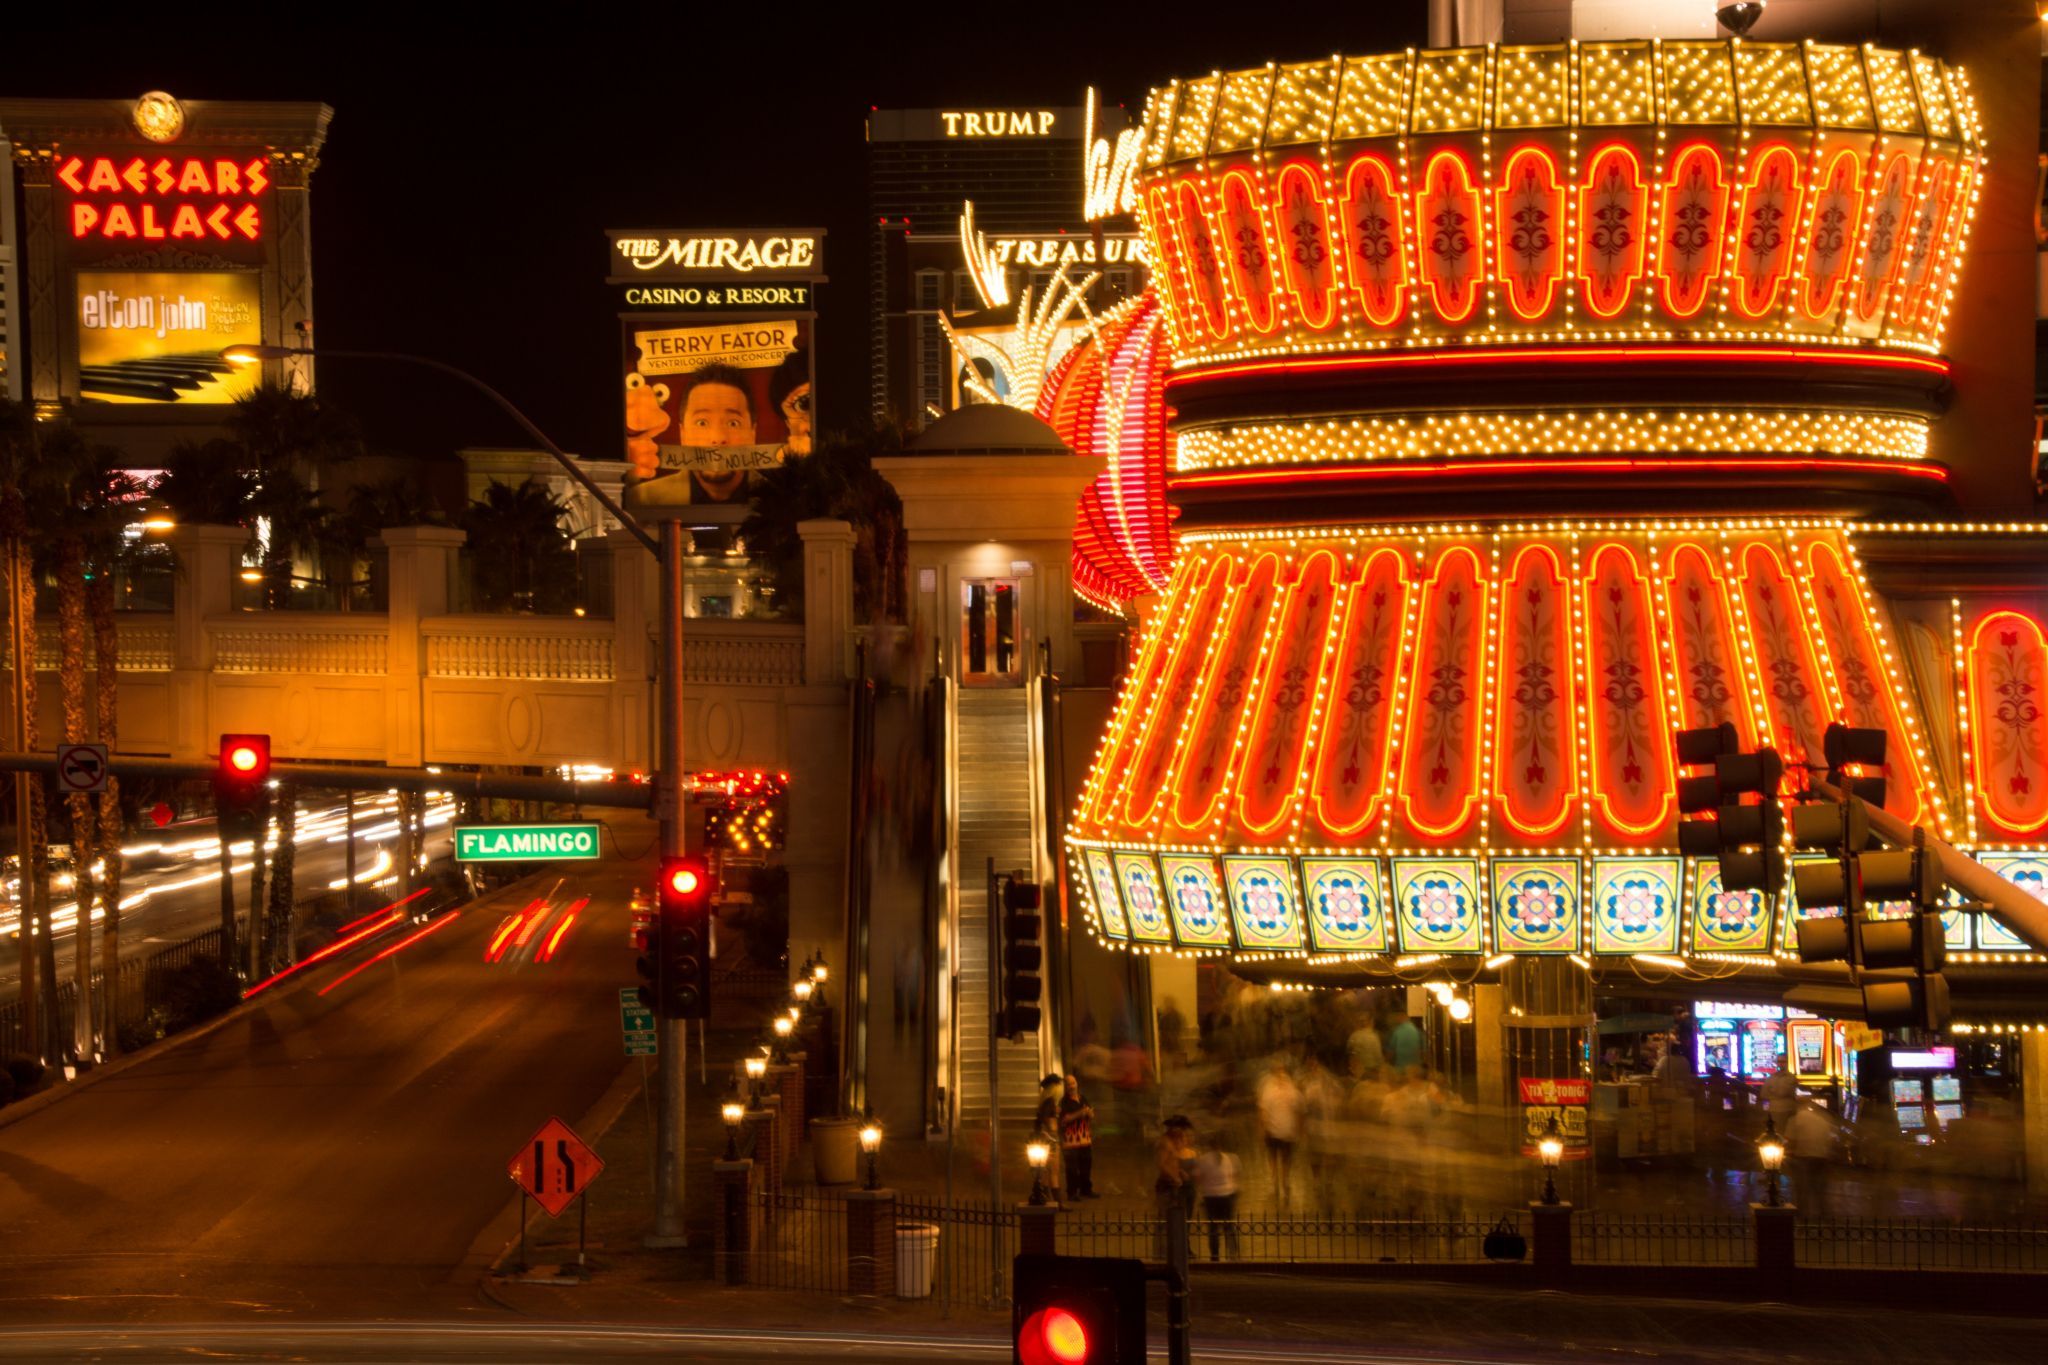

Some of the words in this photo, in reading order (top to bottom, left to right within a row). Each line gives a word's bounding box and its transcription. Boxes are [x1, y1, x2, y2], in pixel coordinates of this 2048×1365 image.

[942, 111, 1055, 136] TRUMP
[58, 157, 269, 196] CAESARS
[72, 203, 261, 240] PALACE
[616, 238, 660, 257] THE
[633, 237, 814, 272] MIRAGE
[625, 288, 701, 305] CASINO
[706, 290, 722, 305] &
[726, 287, 807, 304] RESORT
[82, 291, 154, 329] elton
[156, 294, 206, 338] john
[646, 335, 713, 355] TERRY
[720, 329, 785, 350] FATOR
[648, 357, 727, 369] VENTRILOQUISM
[740, 350, 788, 362] CONCERT
[666, 452, 691, 466] ALL
[695, 448, 722, 465] HITS
[725, 453, 740, 469] NO
[462, 832, 592, 854] FLAMINGO
